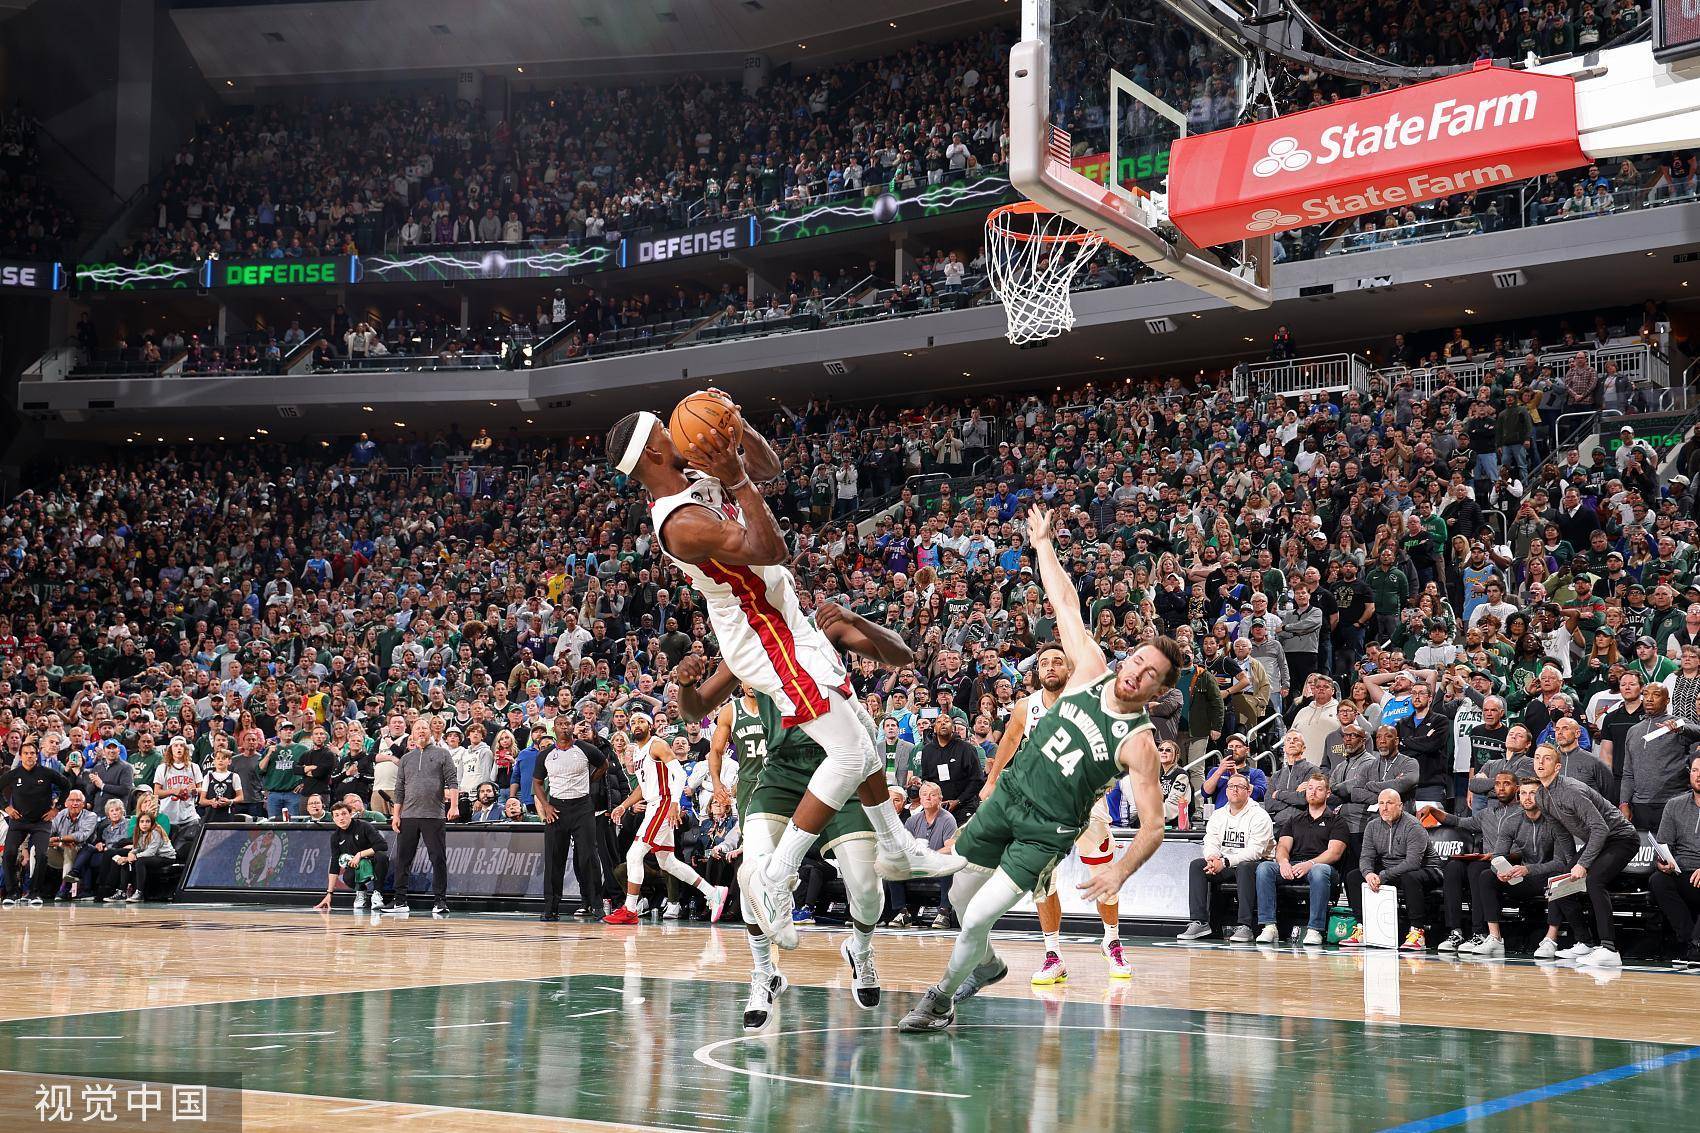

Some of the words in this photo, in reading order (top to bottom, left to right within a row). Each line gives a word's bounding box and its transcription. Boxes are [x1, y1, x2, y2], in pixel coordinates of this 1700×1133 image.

[1316, 112, 1425, 165] State
[1427, 90, 1538, 141] Farm
[1072, 151, 1169, 182] FENSE
[1302, 185, 1407, 220] State
[1408, 163, 1514, 198] Farm
[639, 227, 736, 263] DEFENSE
[0, 266, 36, 287] SE
[226, 263, 336, 286] DEFENSE
[1497, 272, 1517, 288] 117
[1149, 320, 1167, 333] 117
[826, 362, 845, 375] 116
[280, 407, 297, 417] 115
[1624, 615, 1647, 625] BUCK
[1457, 711, 1483, 723] BUCKS
[1459, 724, 1473, 738] 24
[745, 739, 768, 758] 34
[1041, 726, 1085, 777] 24
[166, 775, 194, 788] BUCKS
[1431, 840, 1464, 856] AYOFFS
[300, 848, 320, 874] VS
